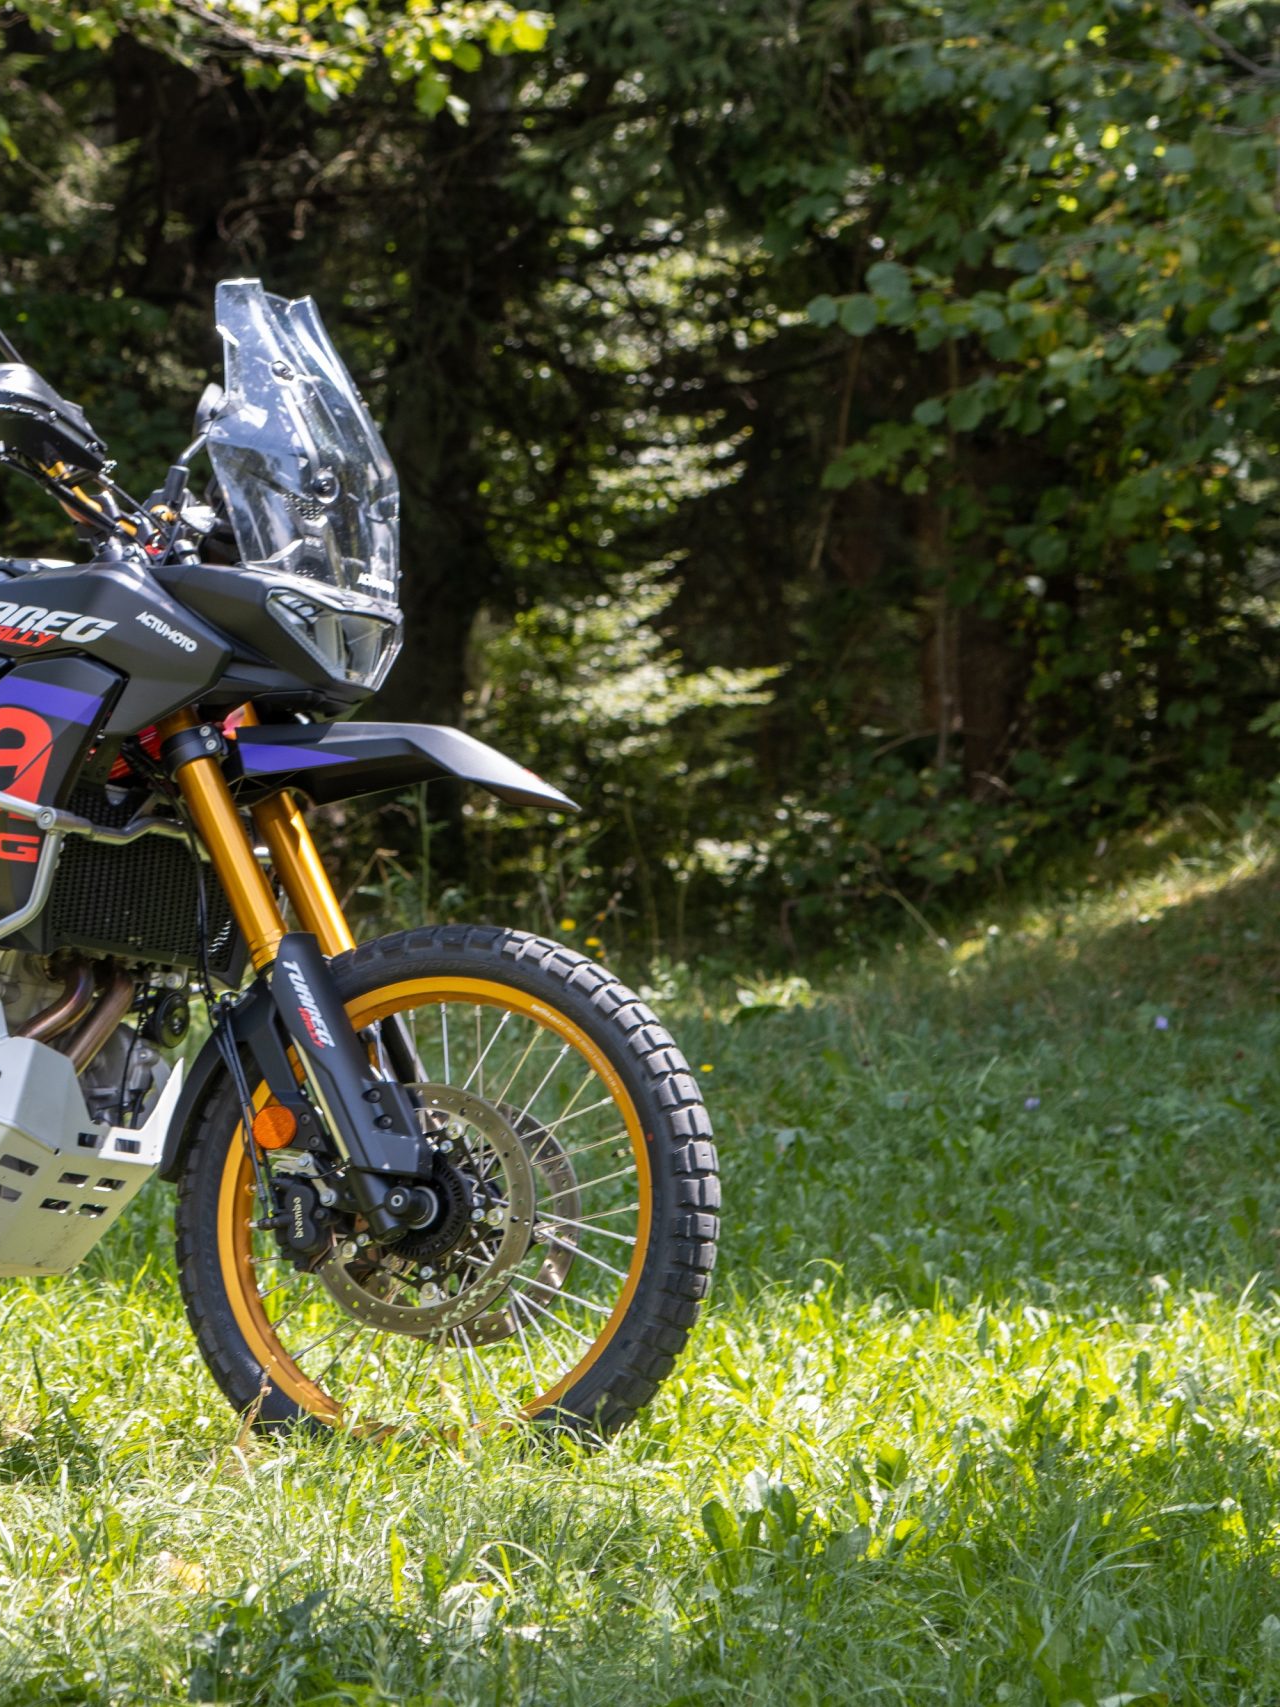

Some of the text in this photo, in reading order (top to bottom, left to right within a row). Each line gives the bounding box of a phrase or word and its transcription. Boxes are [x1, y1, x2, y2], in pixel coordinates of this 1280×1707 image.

[135, 611, 198, 652] ACTUMOTO
[282, 961, 336, 1048] TUAREG
[292, 1196, 304, 1239] brembo
